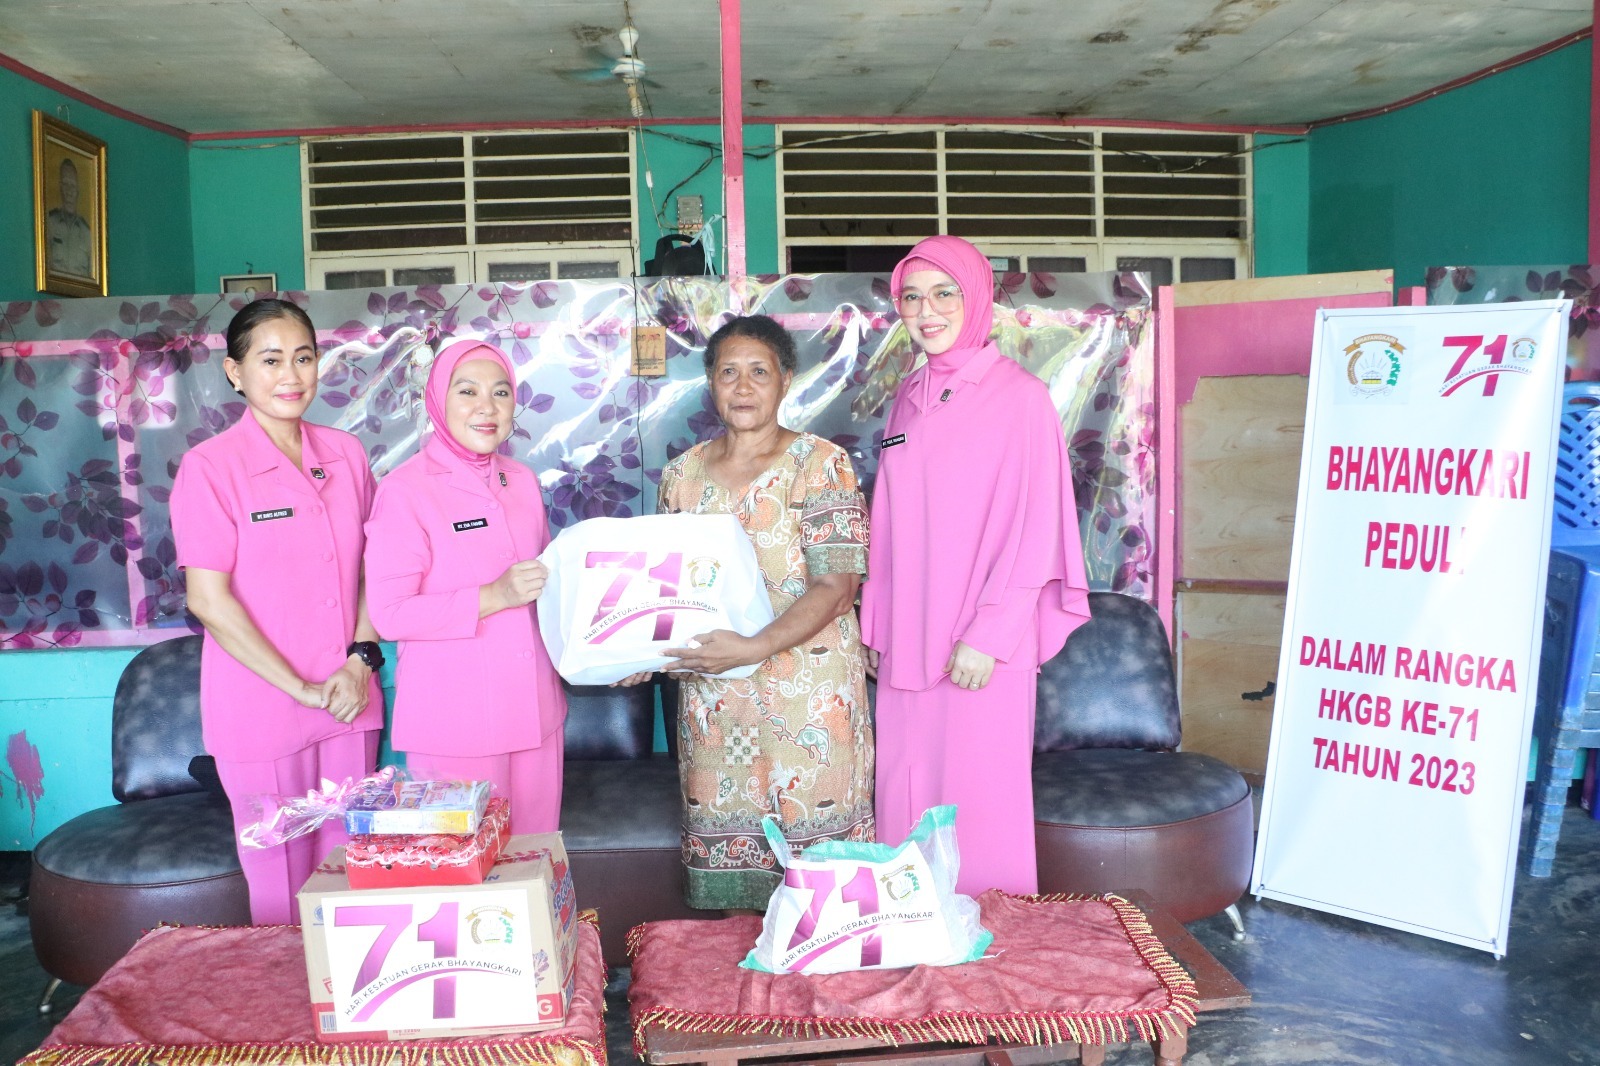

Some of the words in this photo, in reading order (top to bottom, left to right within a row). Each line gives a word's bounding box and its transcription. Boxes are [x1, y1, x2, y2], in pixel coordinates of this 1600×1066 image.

[1442, 334, 1508, 397] 71
[1326, 445, 1531, 500] BHAYANGKARI
[584, 551, 684, 642] 71
[1299, 635, 1387, 676] DALAM
[1394, 646, 1517, 693] RANGKA
[1318, 687, 1392, 729] HKGB
[1400, 699, 1480, 742] KE-71
[1312, 737, 1402, 782] TAHUN
[1408, 753, 1476, 796] 2023
[780, 951, 798, 968] HARI
[796, 930, 840, 955] KESATUAN
[840, 918, 870, 933] GERAK
[784, 866, 883, 968] 71
[334, 902, 460, 1020] 71
[344, 996, 364, 1017] HARI
[361, 968, 410, 1000] KESATUAN
[410, 960, 445, 974] GERAK
[446, 959, 523, 977] BHAYANGKARI
